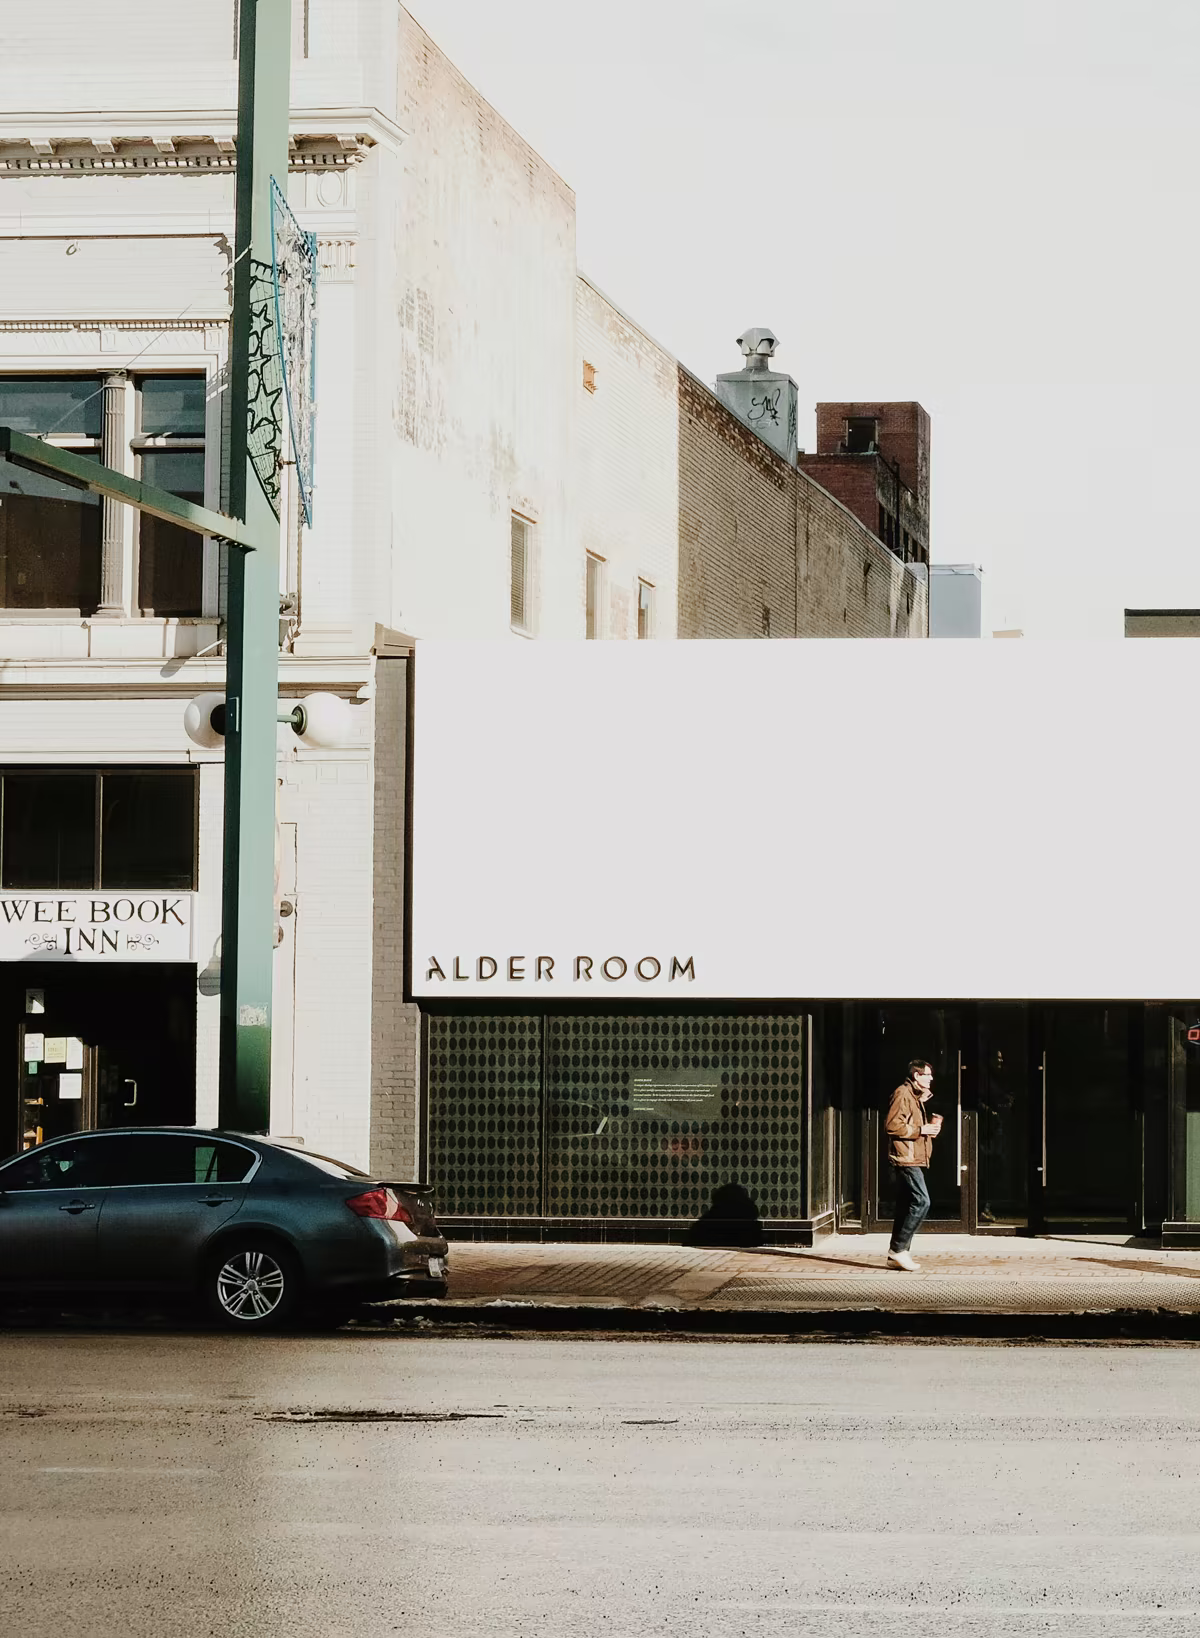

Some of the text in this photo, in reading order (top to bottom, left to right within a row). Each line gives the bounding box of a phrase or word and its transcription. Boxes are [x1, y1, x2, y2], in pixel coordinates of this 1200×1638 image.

[0, 898, 187, 926] WEE BOOK
[62, 926, 120, 955] INN
[427, 955, 696, 982] ALDER ROOM
